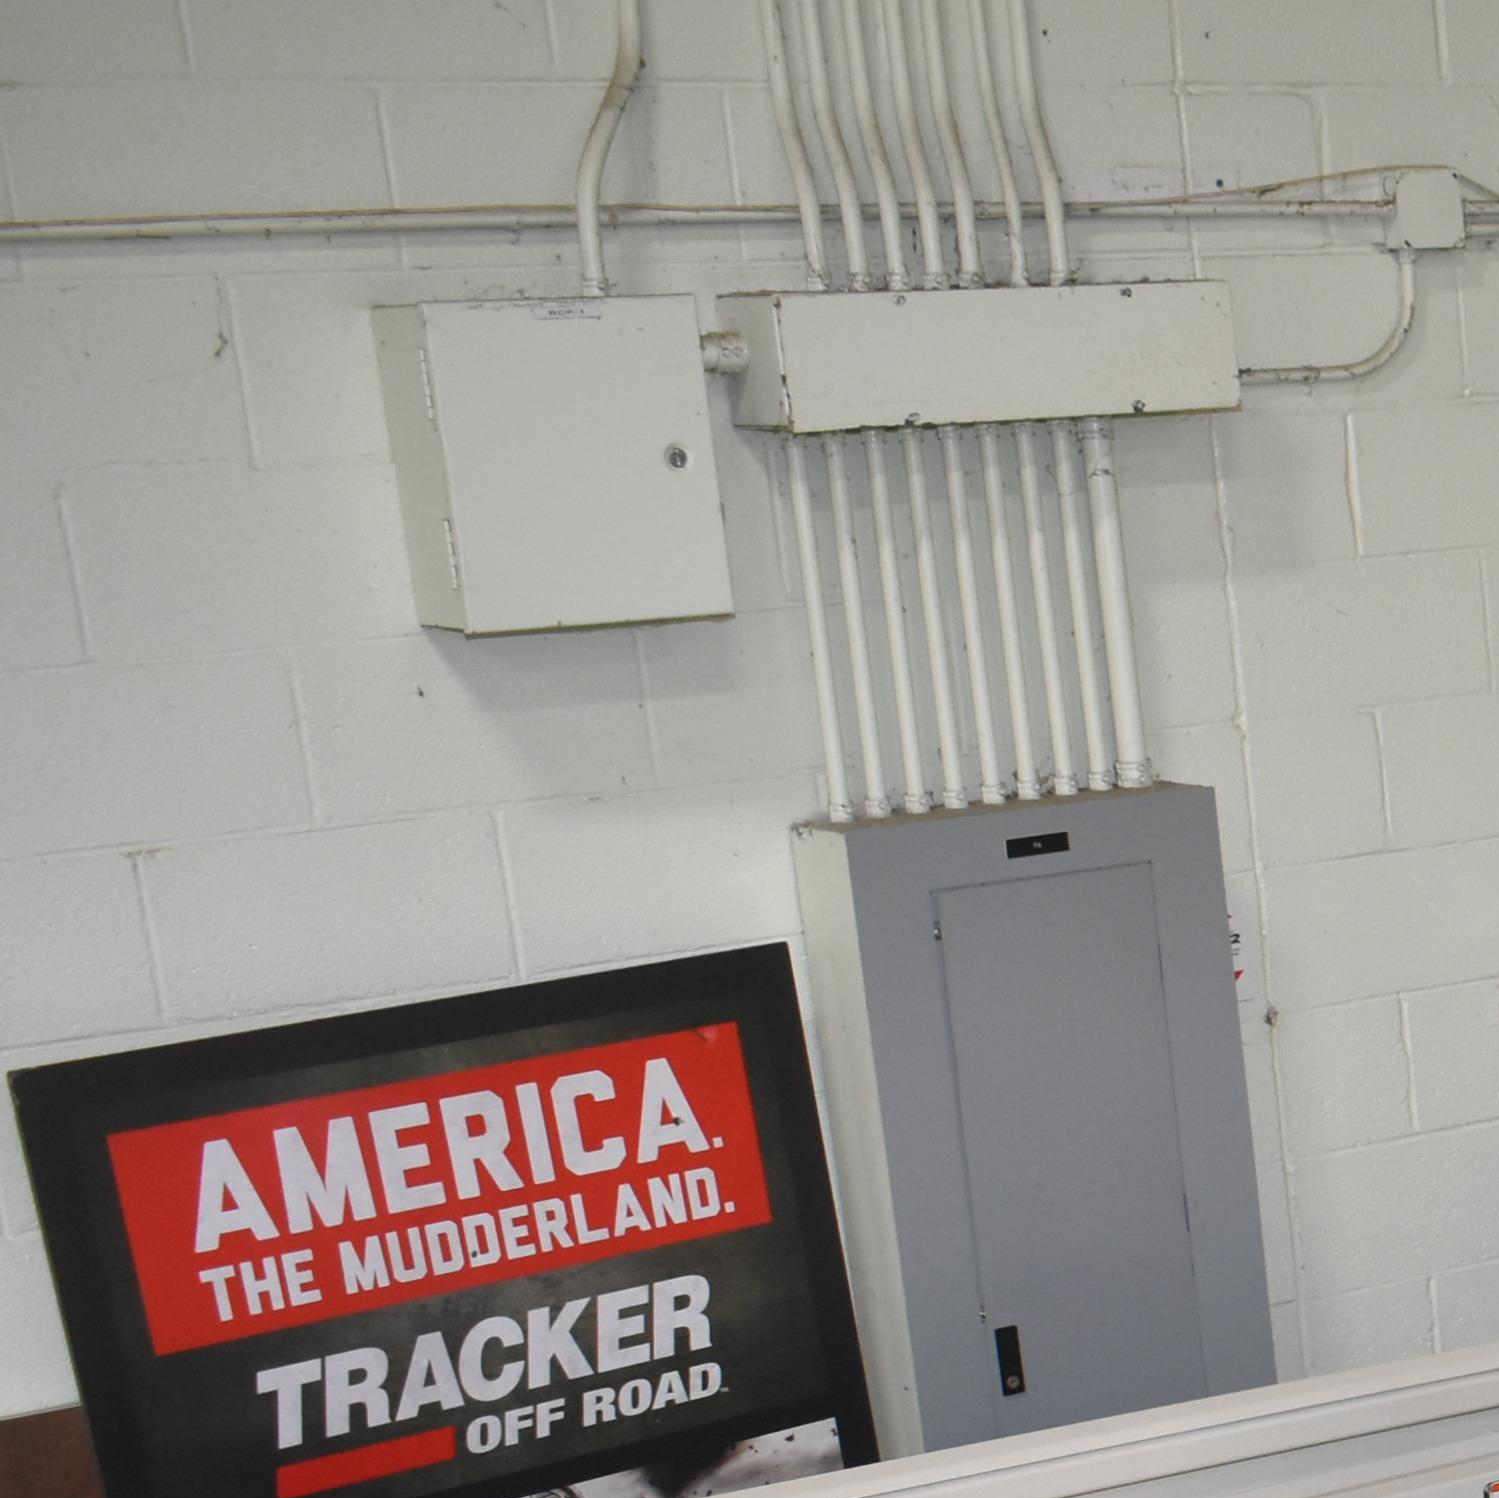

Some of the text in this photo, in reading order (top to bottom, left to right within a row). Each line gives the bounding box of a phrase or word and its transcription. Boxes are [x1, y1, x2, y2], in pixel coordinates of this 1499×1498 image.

[194, 1057, 724, 1253] AMERICA.
[199, 1166, 736, 1323] THE MUDDERLAND.
[256, 1273, 713, 1451] TRACKER
[465, 1361, 723, 1455] OFF ROAD
